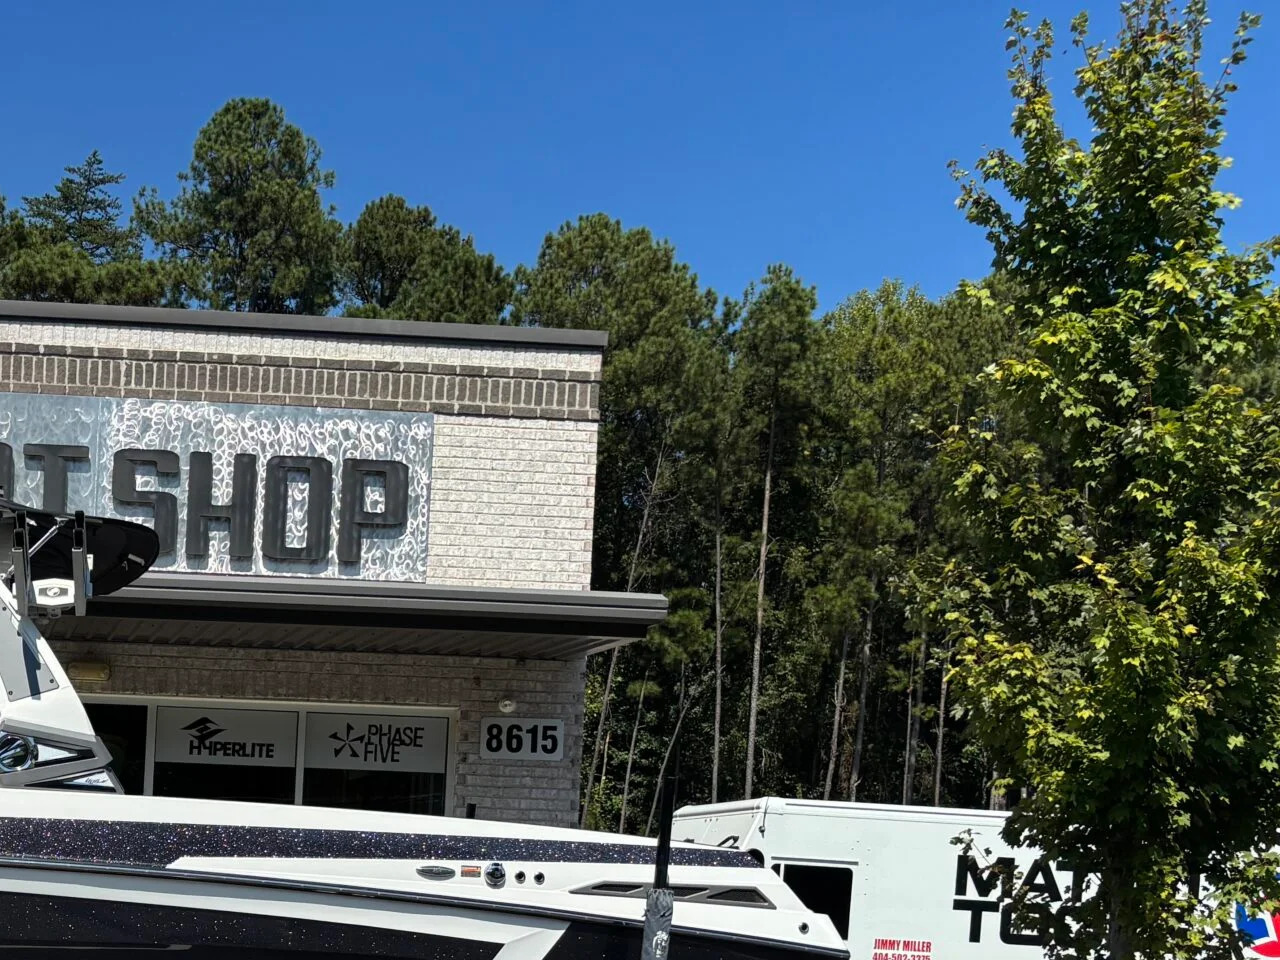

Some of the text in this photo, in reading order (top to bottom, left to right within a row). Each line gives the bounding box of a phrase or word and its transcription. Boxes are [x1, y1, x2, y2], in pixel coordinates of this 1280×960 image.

[111, 448, 410, 563] SHOP
[367, 723, 425, 748] PHASE
[485, 723, 559, 755] 8615
[189, 739, 275, 759] HYPERLITE
[363, 742, 401, 764] FIVE
[954, 853, 1105, 902] MAT
[873, 938, 932, 953] JIMMY MILLER
